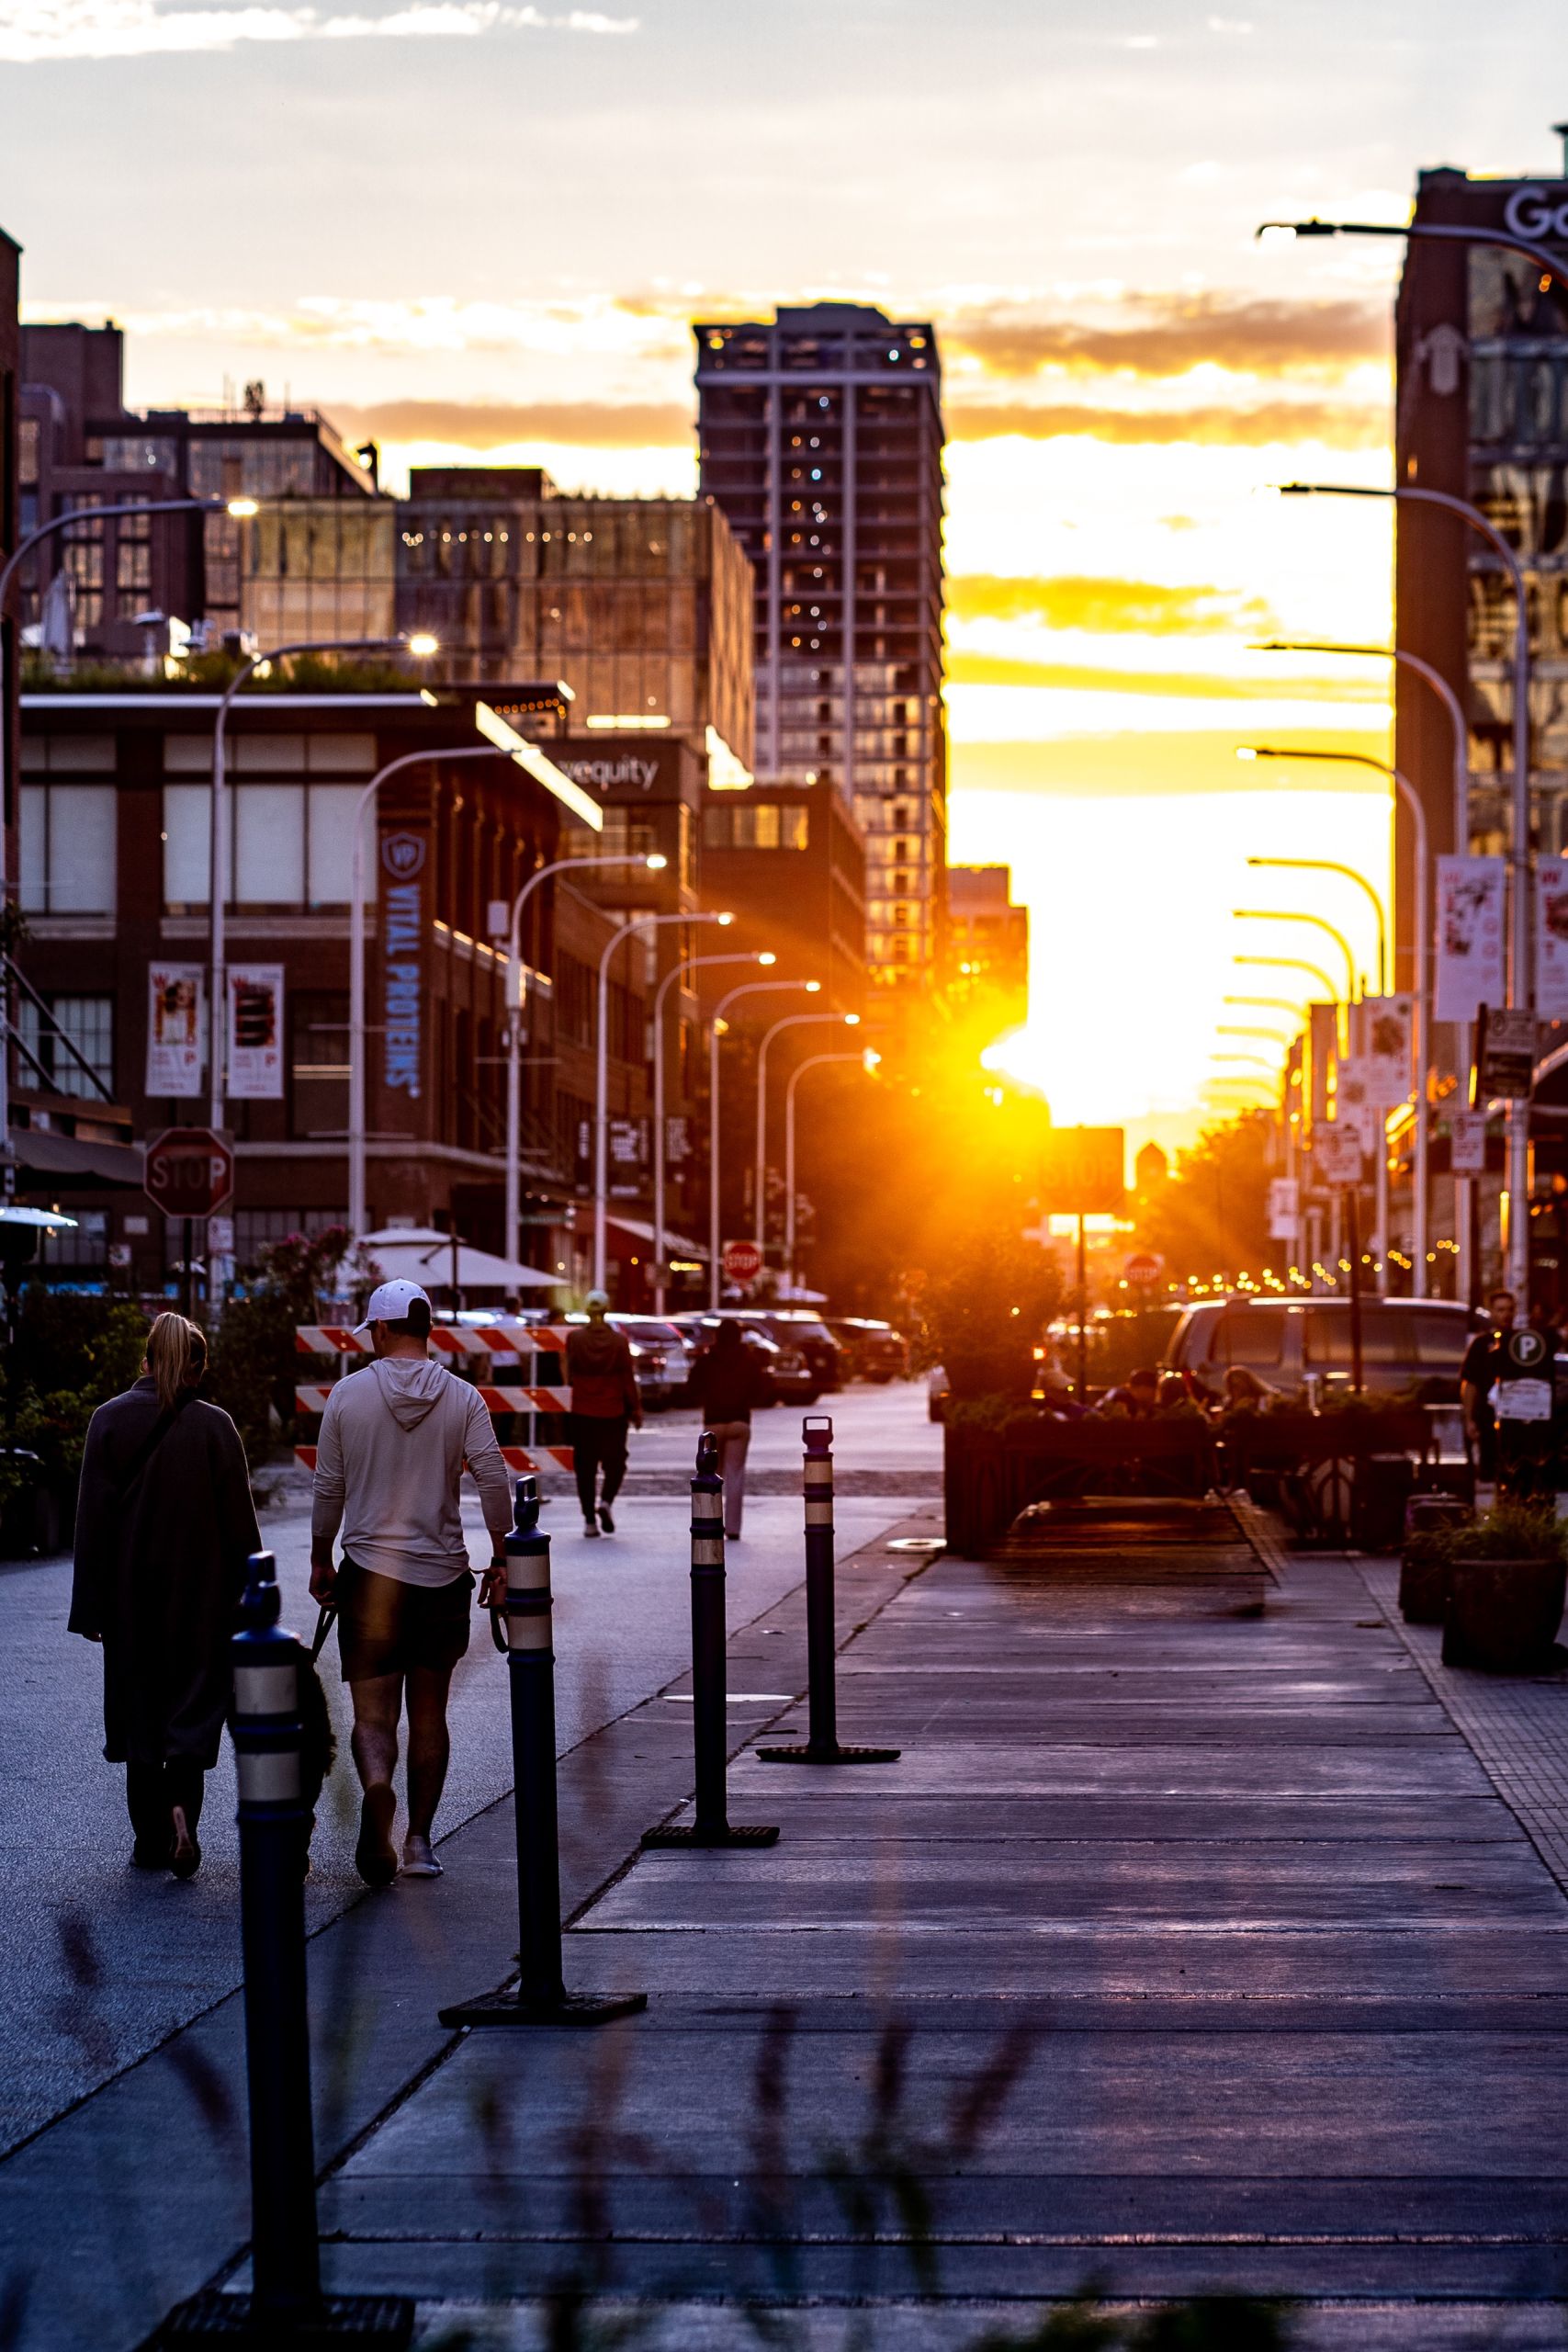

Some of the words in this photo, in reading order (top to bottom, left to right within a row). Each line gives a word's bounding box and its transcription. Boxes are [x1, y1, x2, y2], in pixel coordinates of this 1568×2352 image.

[386, 884, 420, 956] VITAL
[385, 963, 421, 1087] PROTEINS
[152, 1156, 227, 1190] STOP
[727, 1252, 759, 1270] STOP
[1519, 1335, 1538, 1360] P
